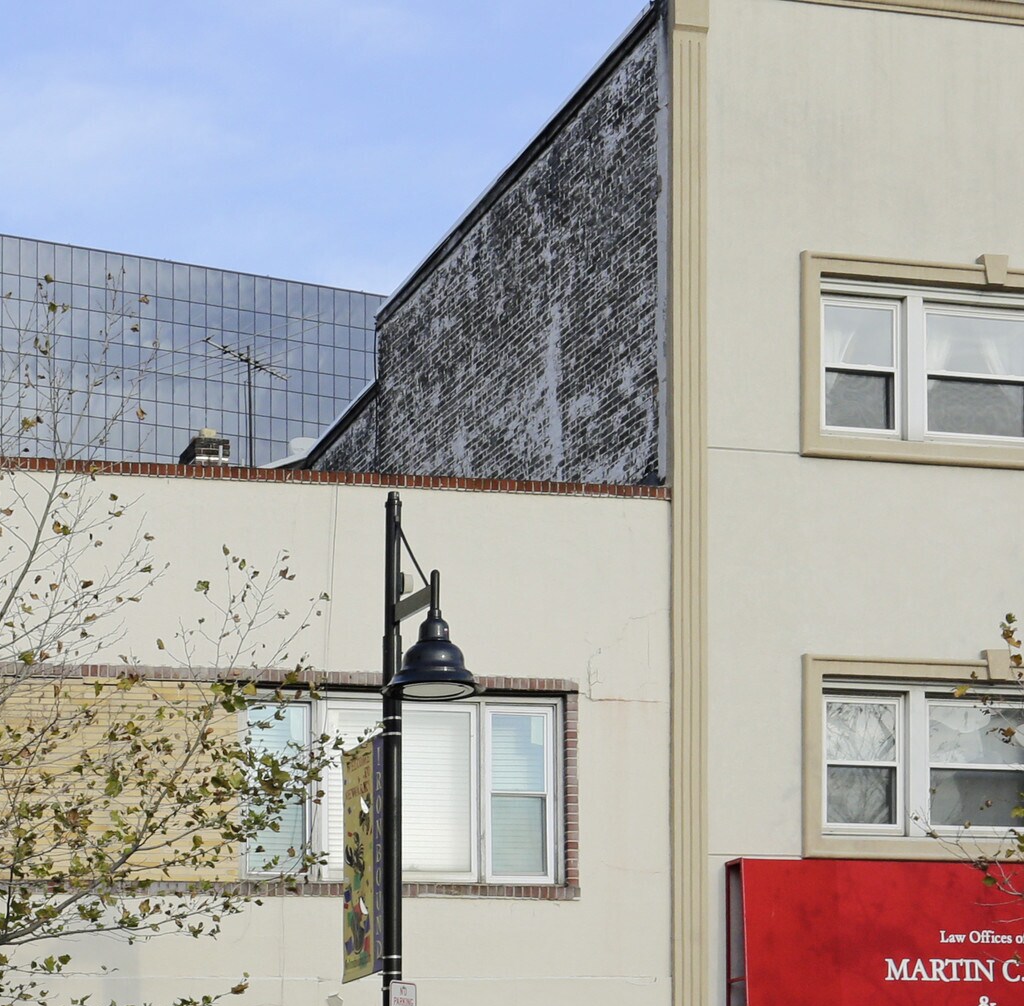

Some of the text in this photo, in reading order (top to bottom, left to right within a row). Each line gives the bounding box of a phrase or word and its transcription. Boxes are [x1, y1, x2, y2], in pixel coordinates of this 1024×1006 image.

[375, 747, 383, 959] IRONBOUND
[939, 930, 966, 944] Law
[969, 929, 1013, 944] Offices
[884, 958, 995, 982] MARTIN
[399, 986, 407, 996] NO
